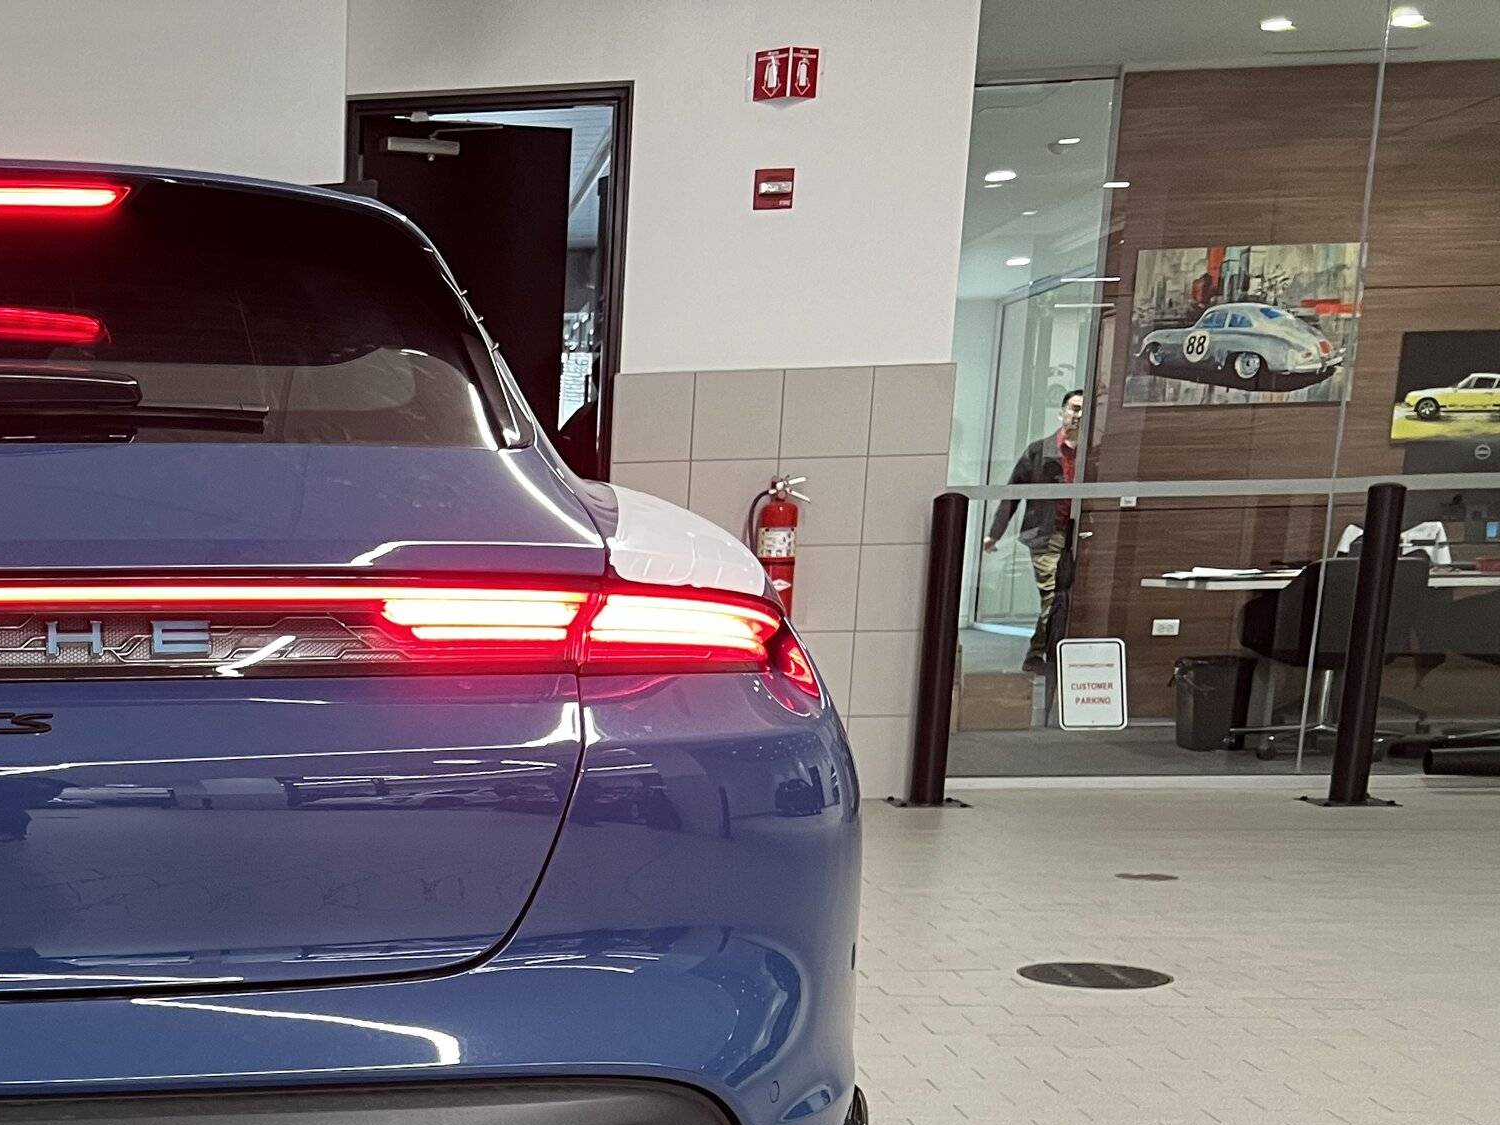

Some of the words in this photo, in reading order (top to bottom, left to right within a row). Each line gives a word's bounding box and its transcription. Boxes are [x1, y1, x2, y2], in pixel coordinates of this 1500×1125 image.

[1186, 335, 1207, 355] 88
[1070, 682, 1114, 691] CUSTOMER
[1075, 696, 1111, 705] PARKING
